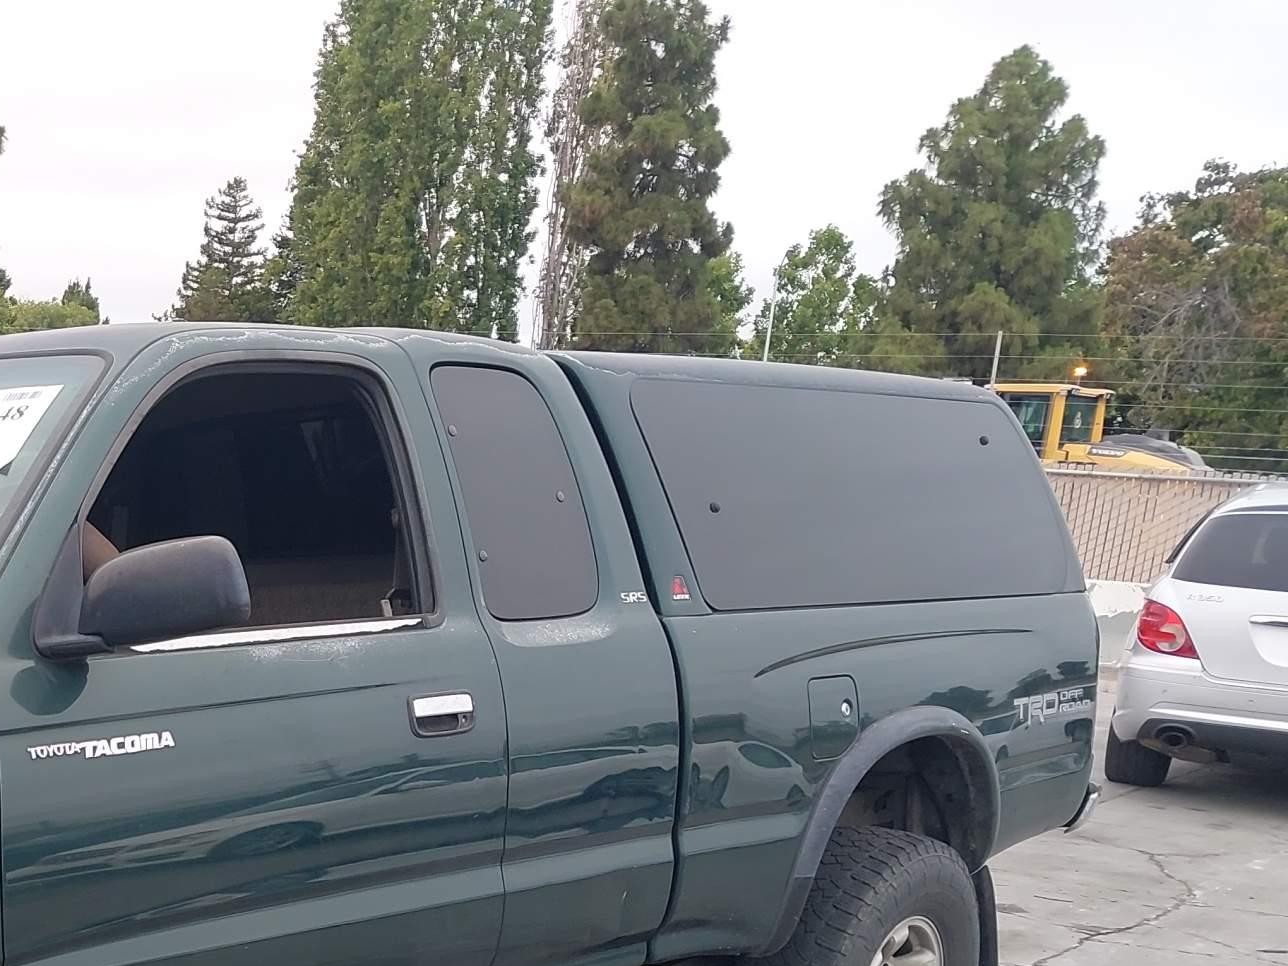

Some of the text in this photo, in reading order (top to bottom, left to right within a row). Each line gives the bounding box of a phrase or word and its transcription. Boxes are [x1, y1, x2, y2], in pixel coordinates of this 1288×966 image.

[1059, 688, 1084, 701] OFF
[1013, 692, 1058, 725] TRD
[1059, 699, 1091, 713] ROAD
[27, 731, 175, 759] TOYOTA TACOMA
